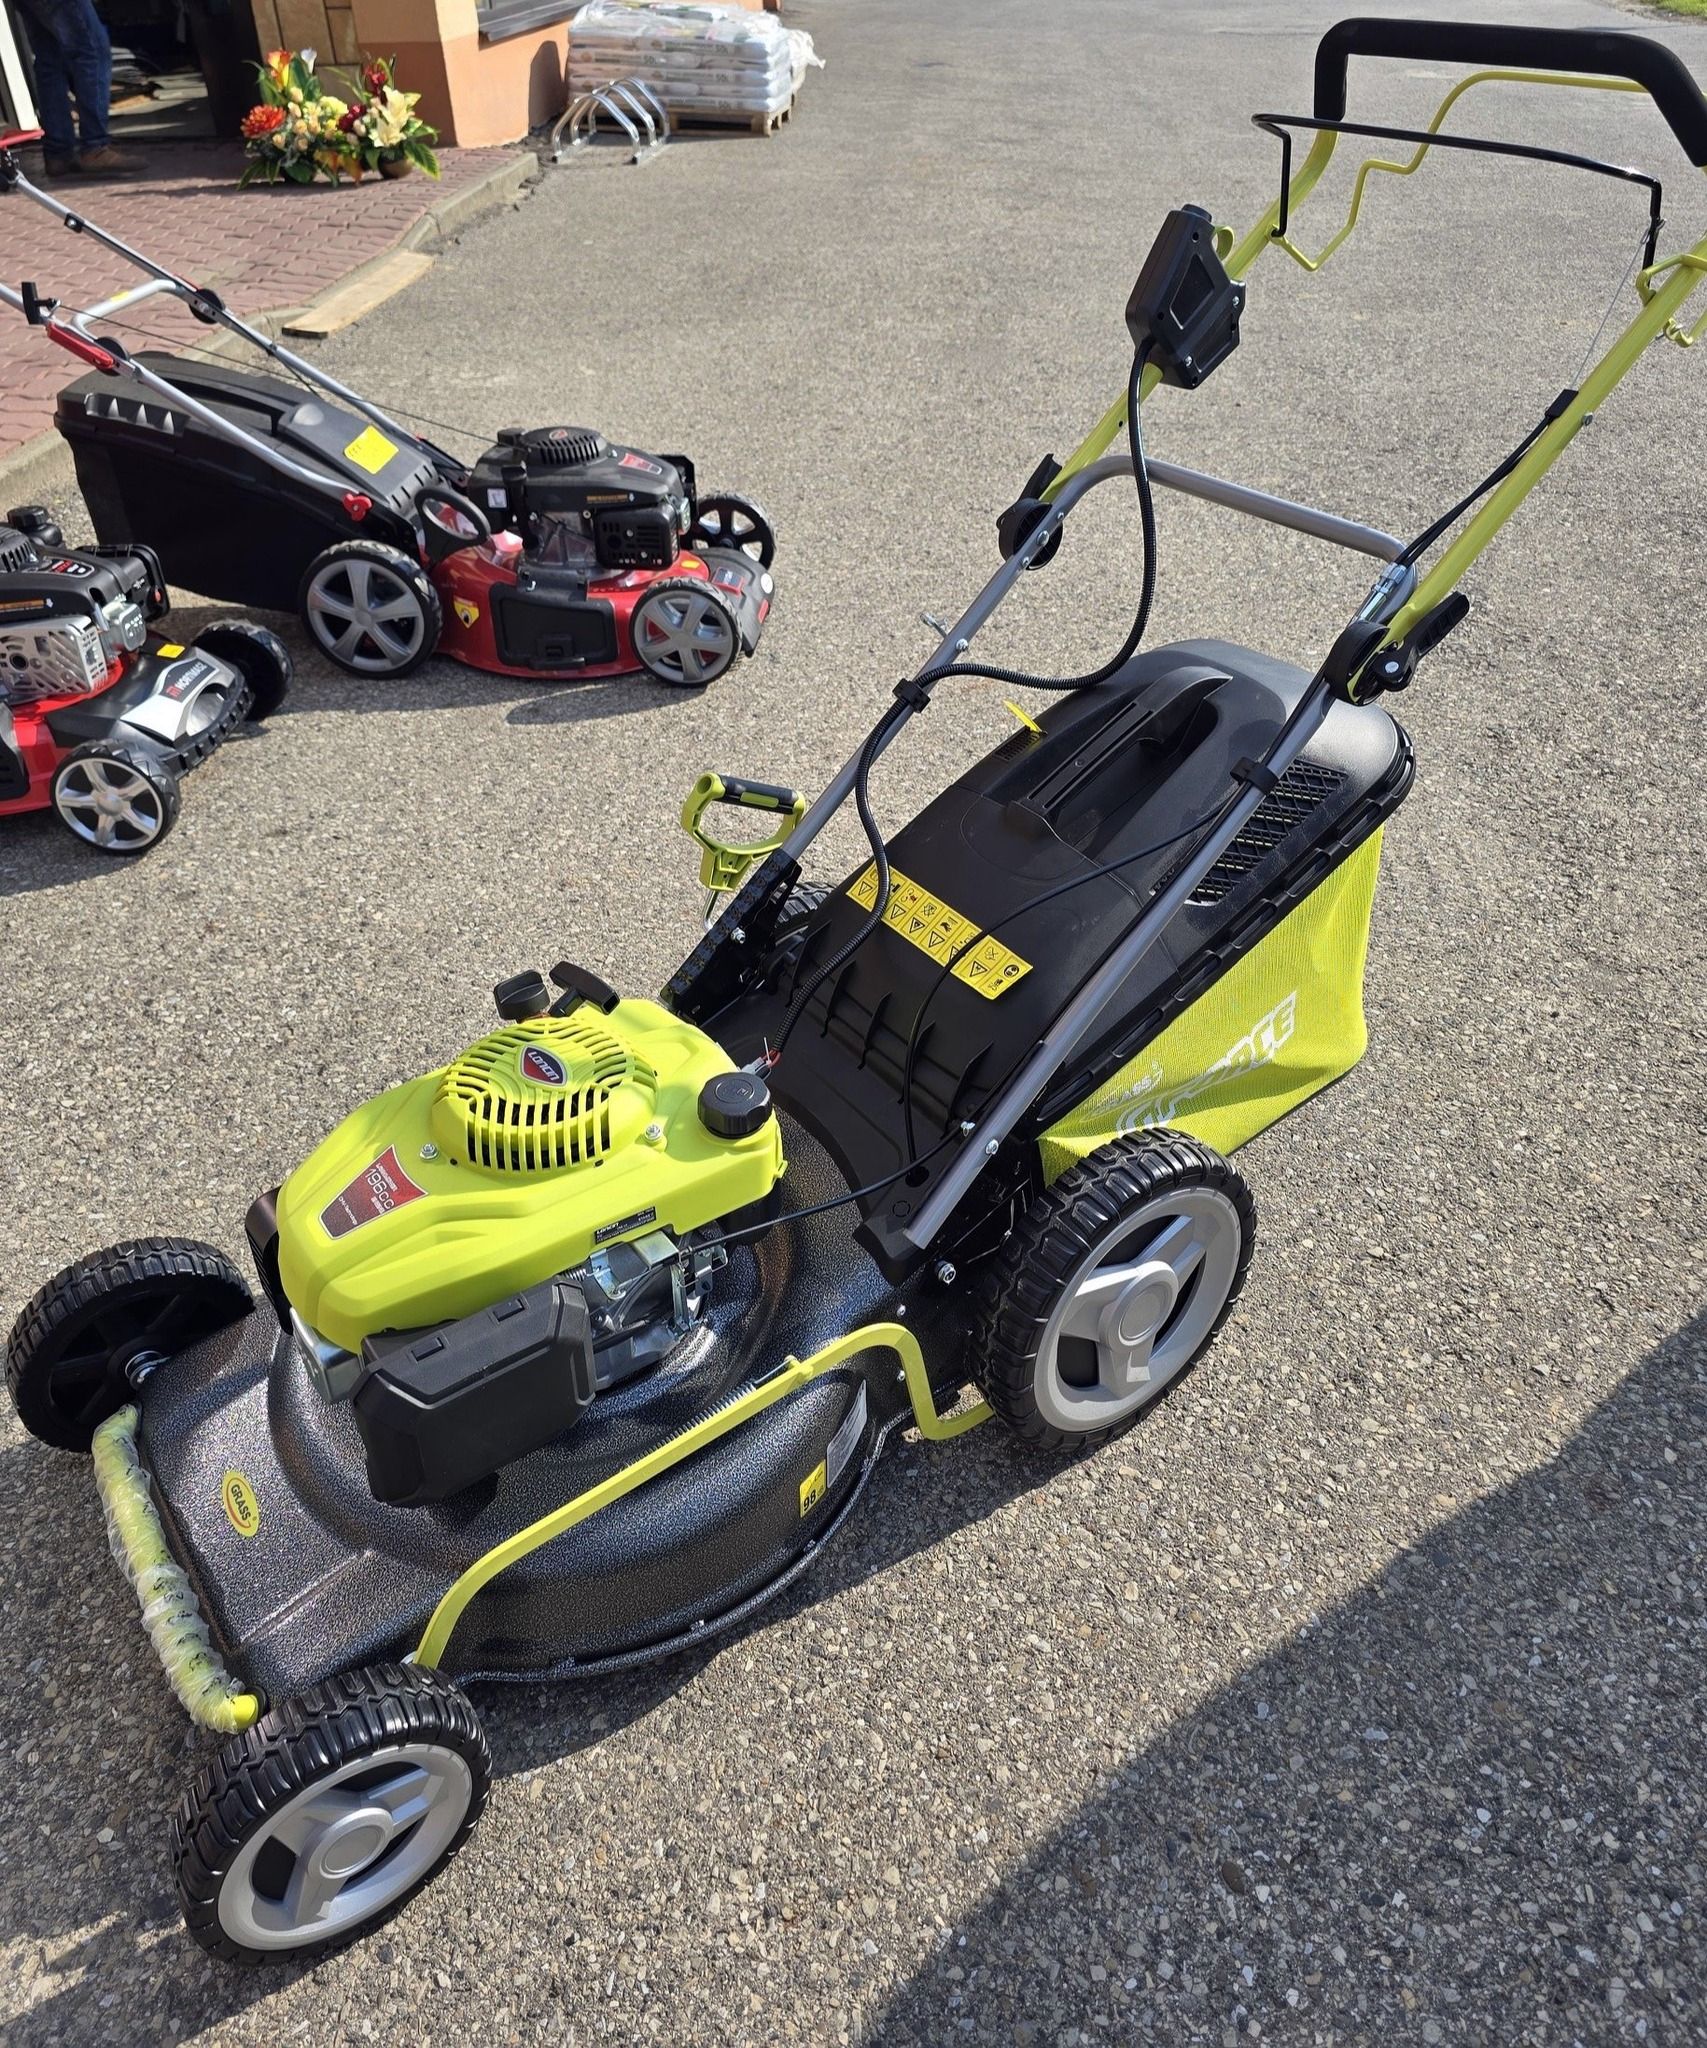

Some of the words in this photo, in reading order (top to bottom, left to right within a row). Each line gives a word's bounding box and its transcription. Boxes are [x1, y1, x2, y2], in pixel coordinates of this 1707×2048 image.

[365, 1167, 395, 1210] 196cc
[231, 1483, 252, 1521] GRASS
[803, 1489, 816, 1512] 98
